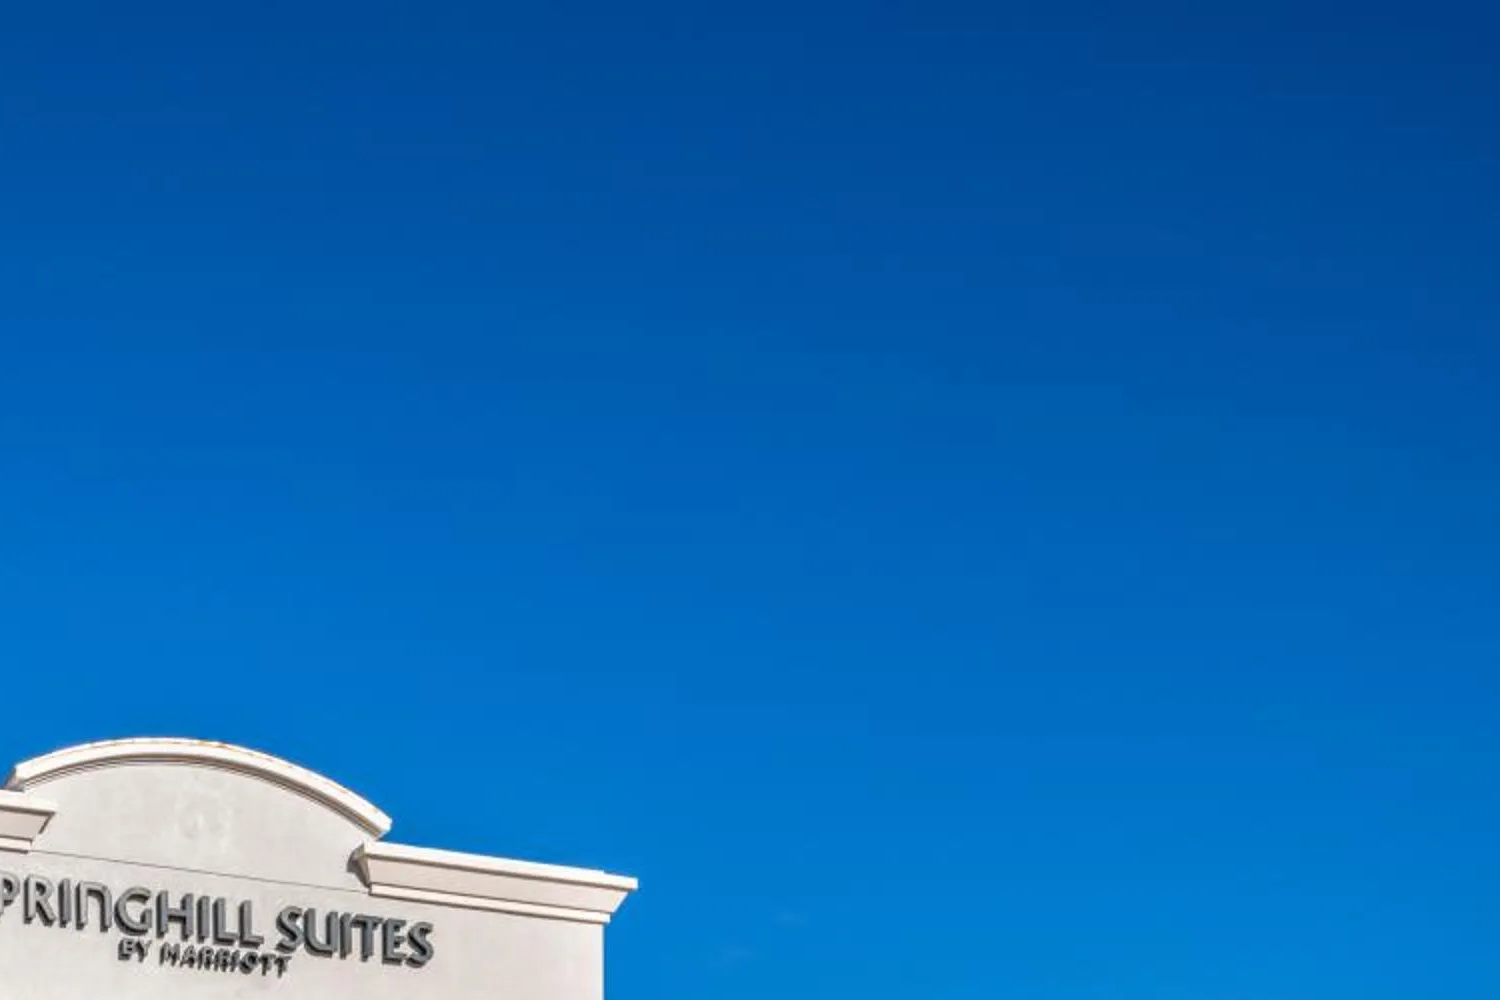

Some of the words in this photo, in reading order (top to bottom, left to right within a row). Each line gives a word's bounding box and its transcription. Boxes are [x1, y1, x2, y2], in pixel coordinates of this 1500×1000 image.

[118, 937, 152, 962] BY
[159, 942, 291, 978] MARRIOTT
[276, 905, 434, 968] SUITES
